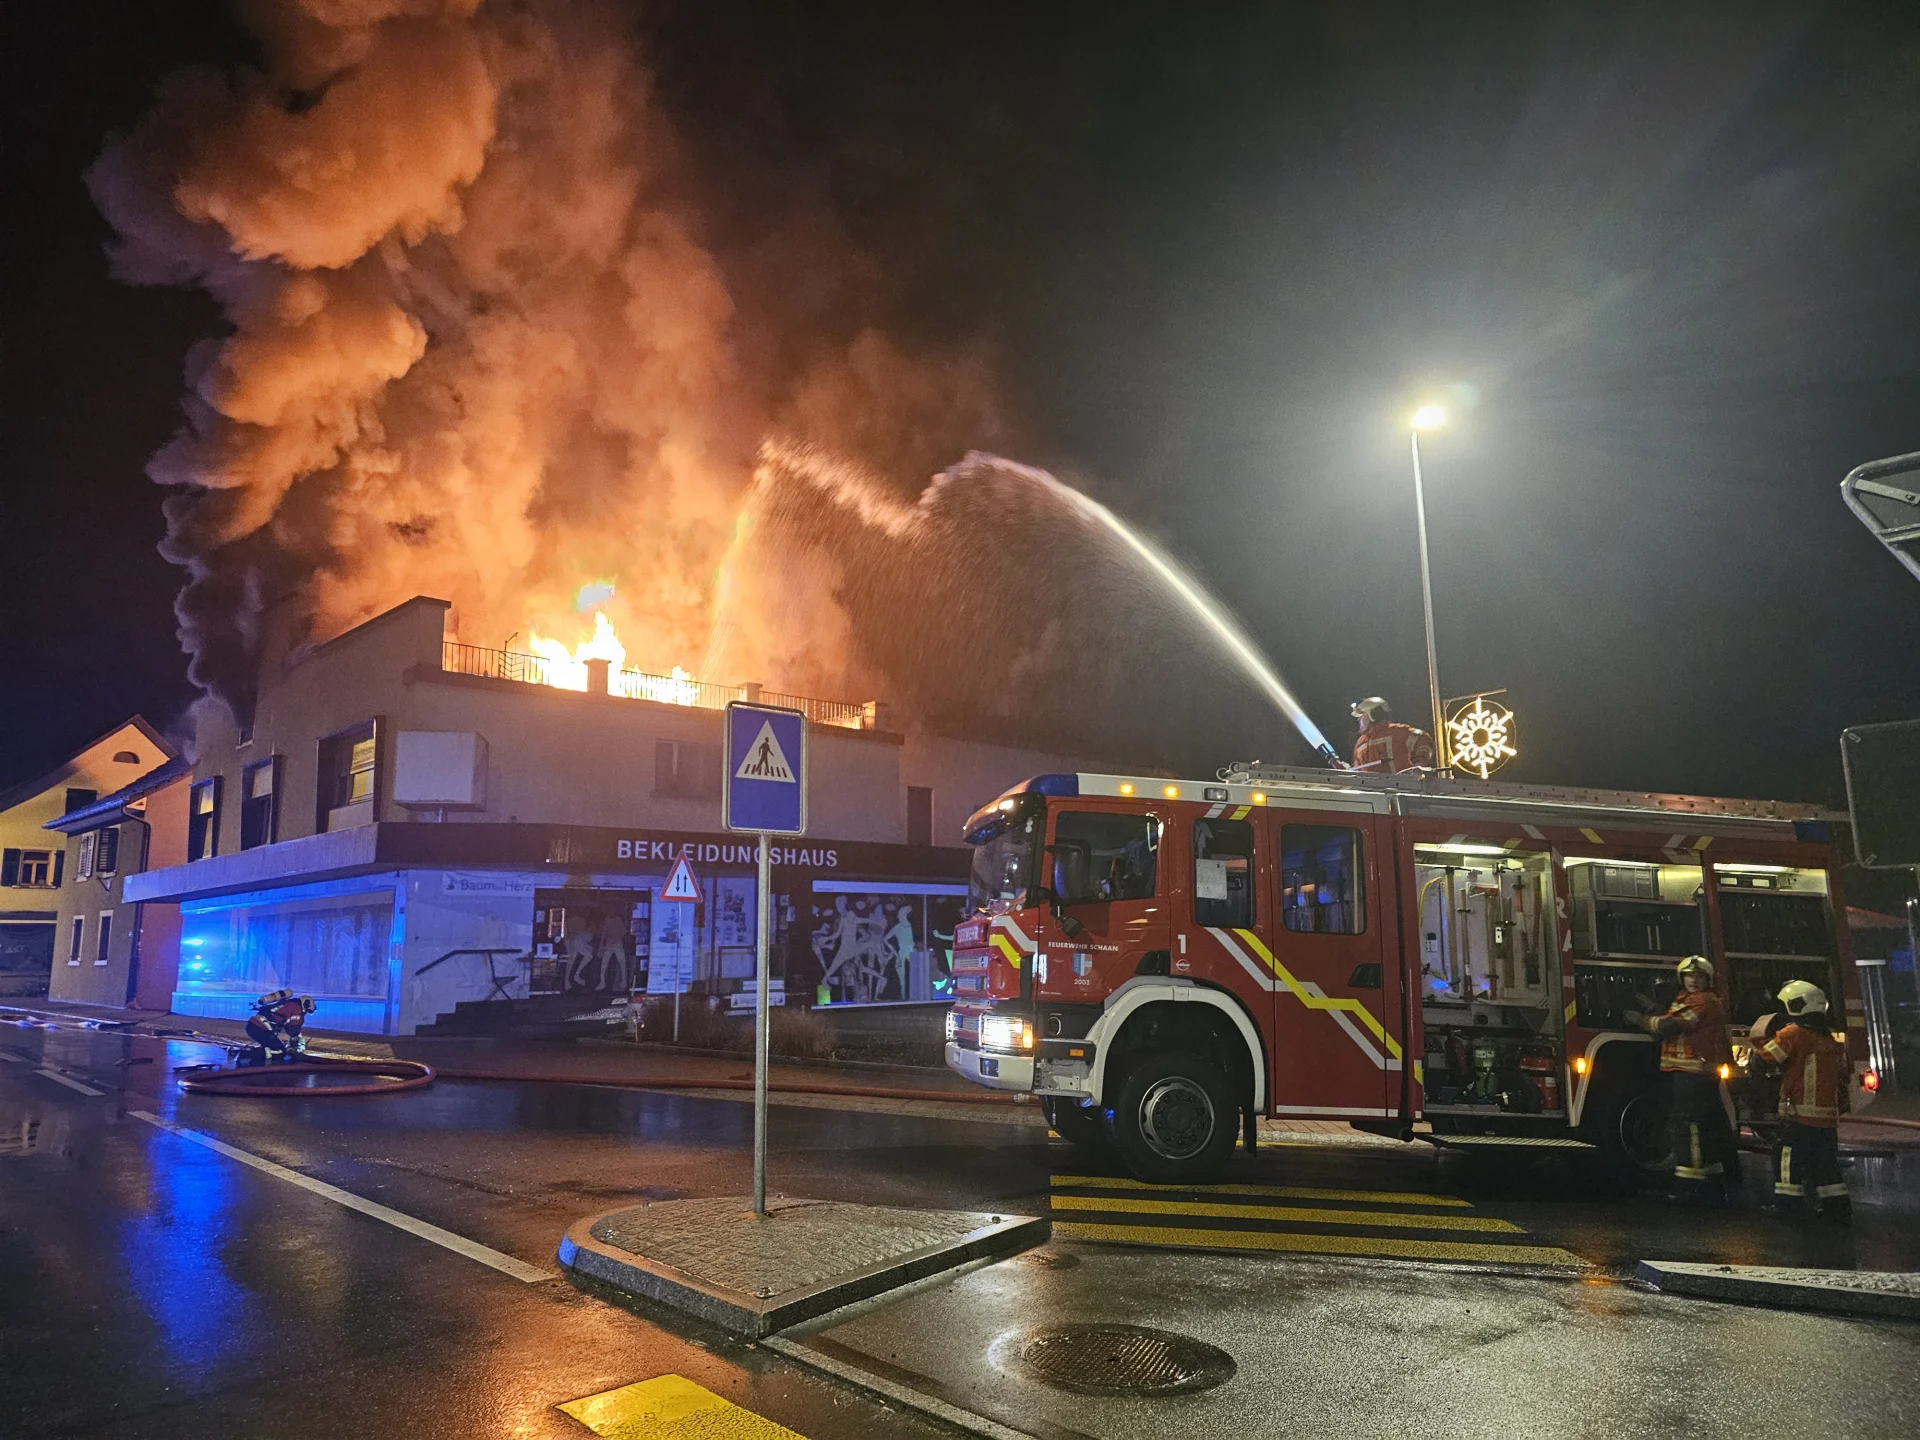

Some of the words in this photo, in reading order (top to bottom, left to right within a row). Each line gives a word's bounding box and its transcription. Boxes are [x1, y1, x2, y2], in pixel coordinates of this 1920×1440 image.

[460, 879, 496, 891] Baum
[504, 880, 532, 891] Herz
[1048, 941, 1088, 950] FEUERWEHR
[1089, 943, 1119, 952] SCHAAN
[1177, 934, 1187, 954] 1
